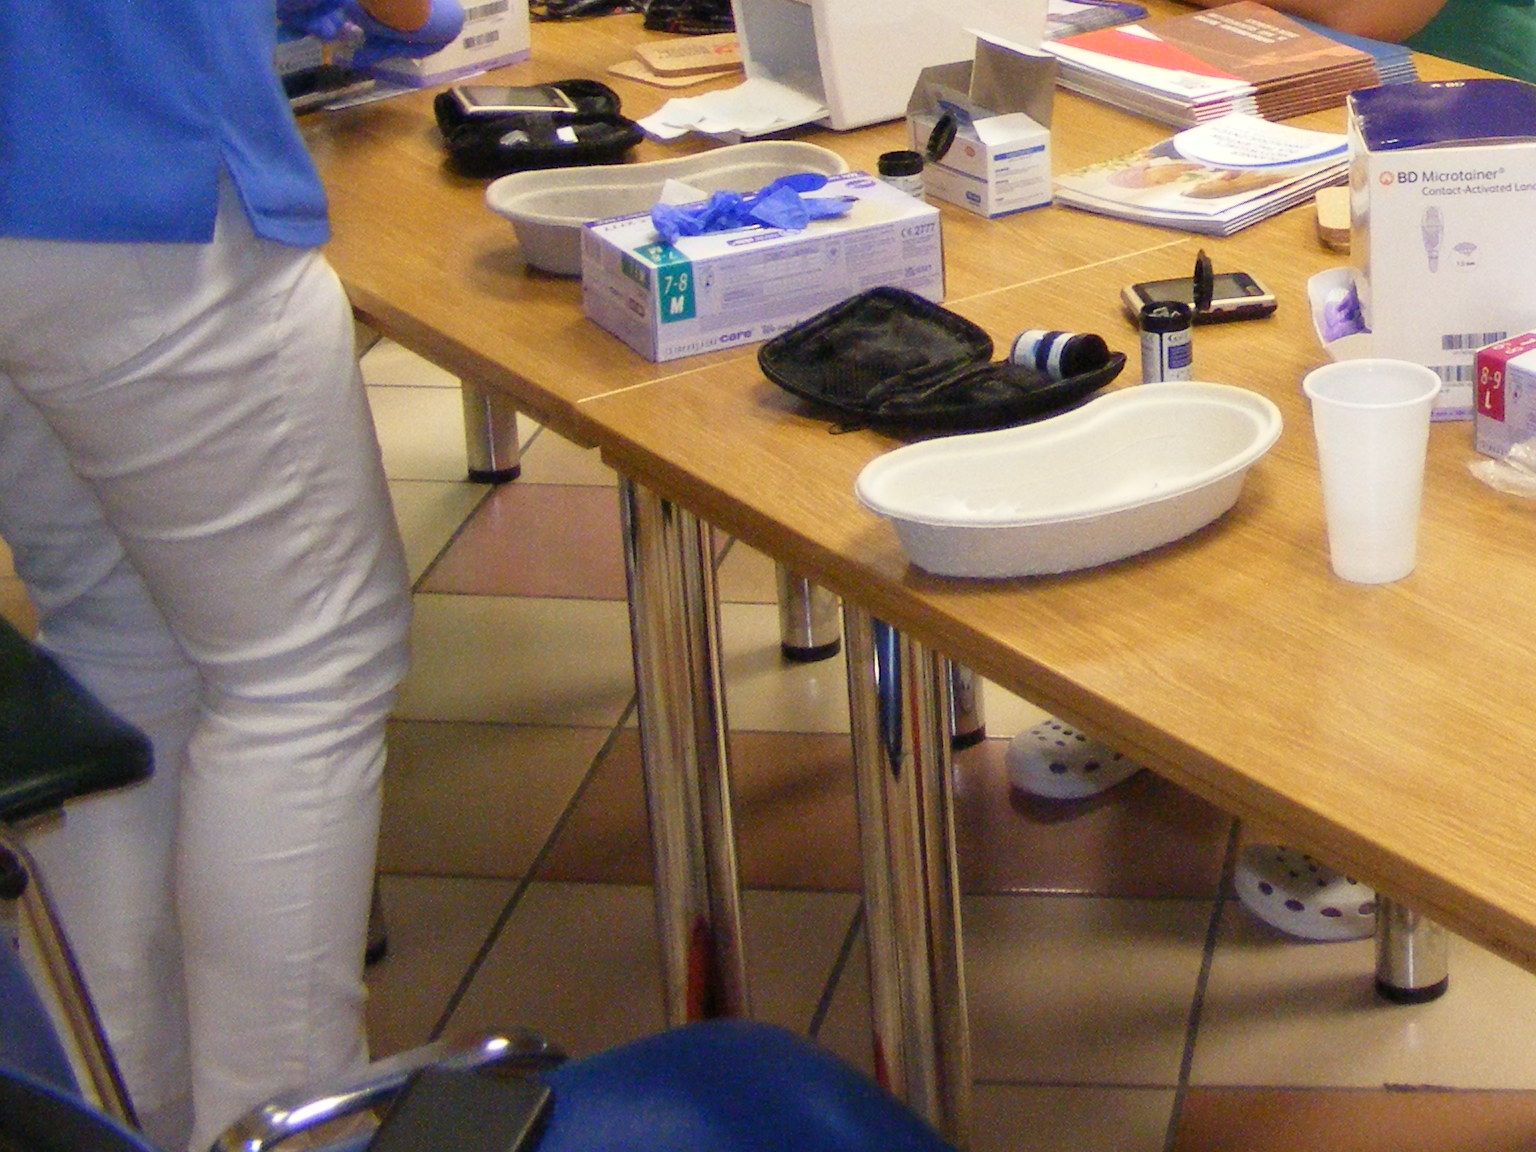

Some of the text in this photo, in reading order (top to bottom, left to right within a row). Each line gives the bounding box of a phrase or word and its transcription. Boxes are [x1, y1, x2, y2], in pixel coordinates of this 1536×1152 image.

[1397, 171, 1418, 184] BD
[1421, 184, 1512, 197] Contact-Activated
[665, 273, 688, 293] 7-8
[670, 295, 685, 314] M
[1481, 366, 1501, 389] 8-9
[1484, 391, 1492, 409] L
